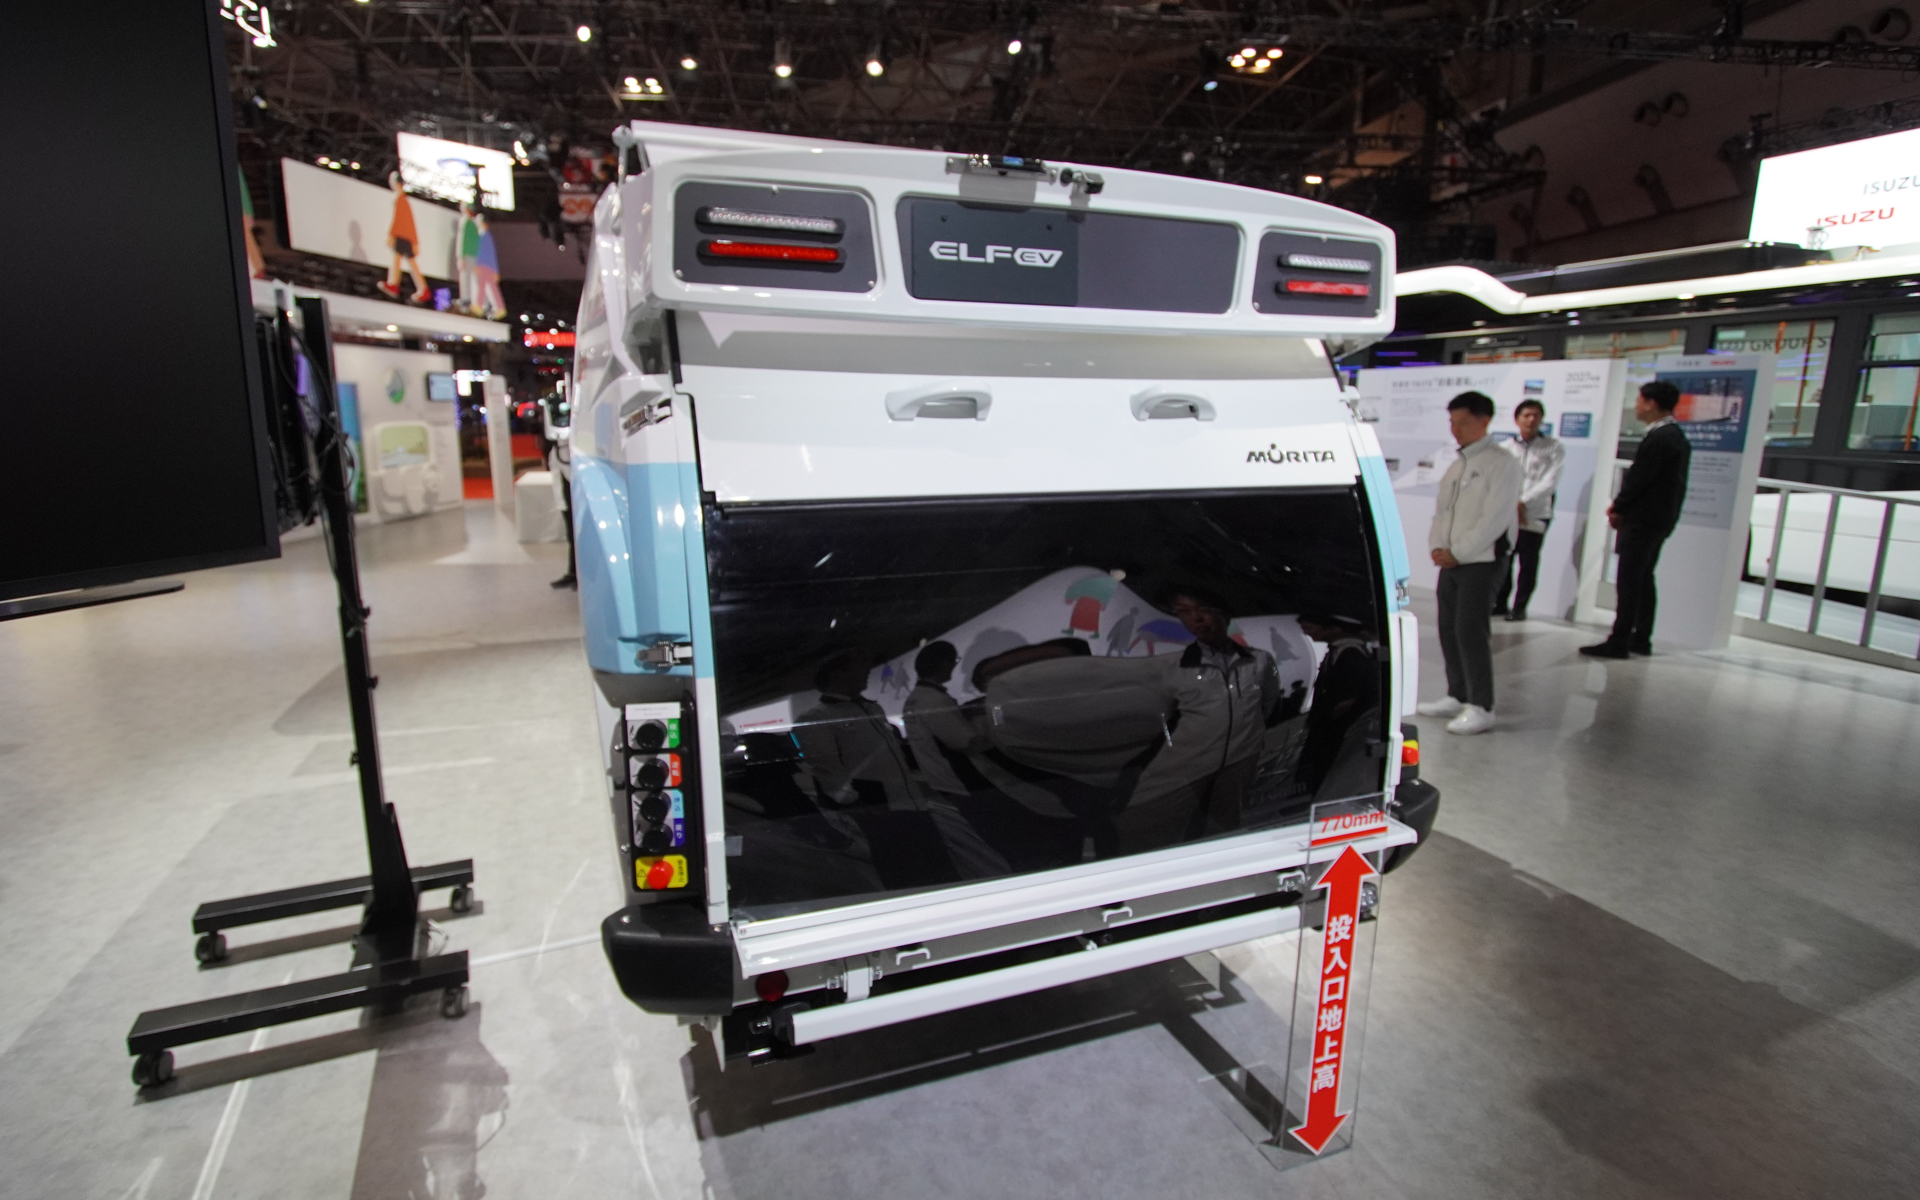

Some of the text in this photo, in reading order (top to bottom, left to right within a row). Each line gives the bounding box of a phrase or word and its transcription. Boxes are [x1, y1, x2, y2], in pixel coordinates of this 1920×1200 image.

[1817, 207, 1895, 228] ISUZU
[1246, 443, 1336, 464] MORITA
[1319, 810, 1385, 834] 770mm
[1313, 913, 1353, 1093] 投入口地上高
